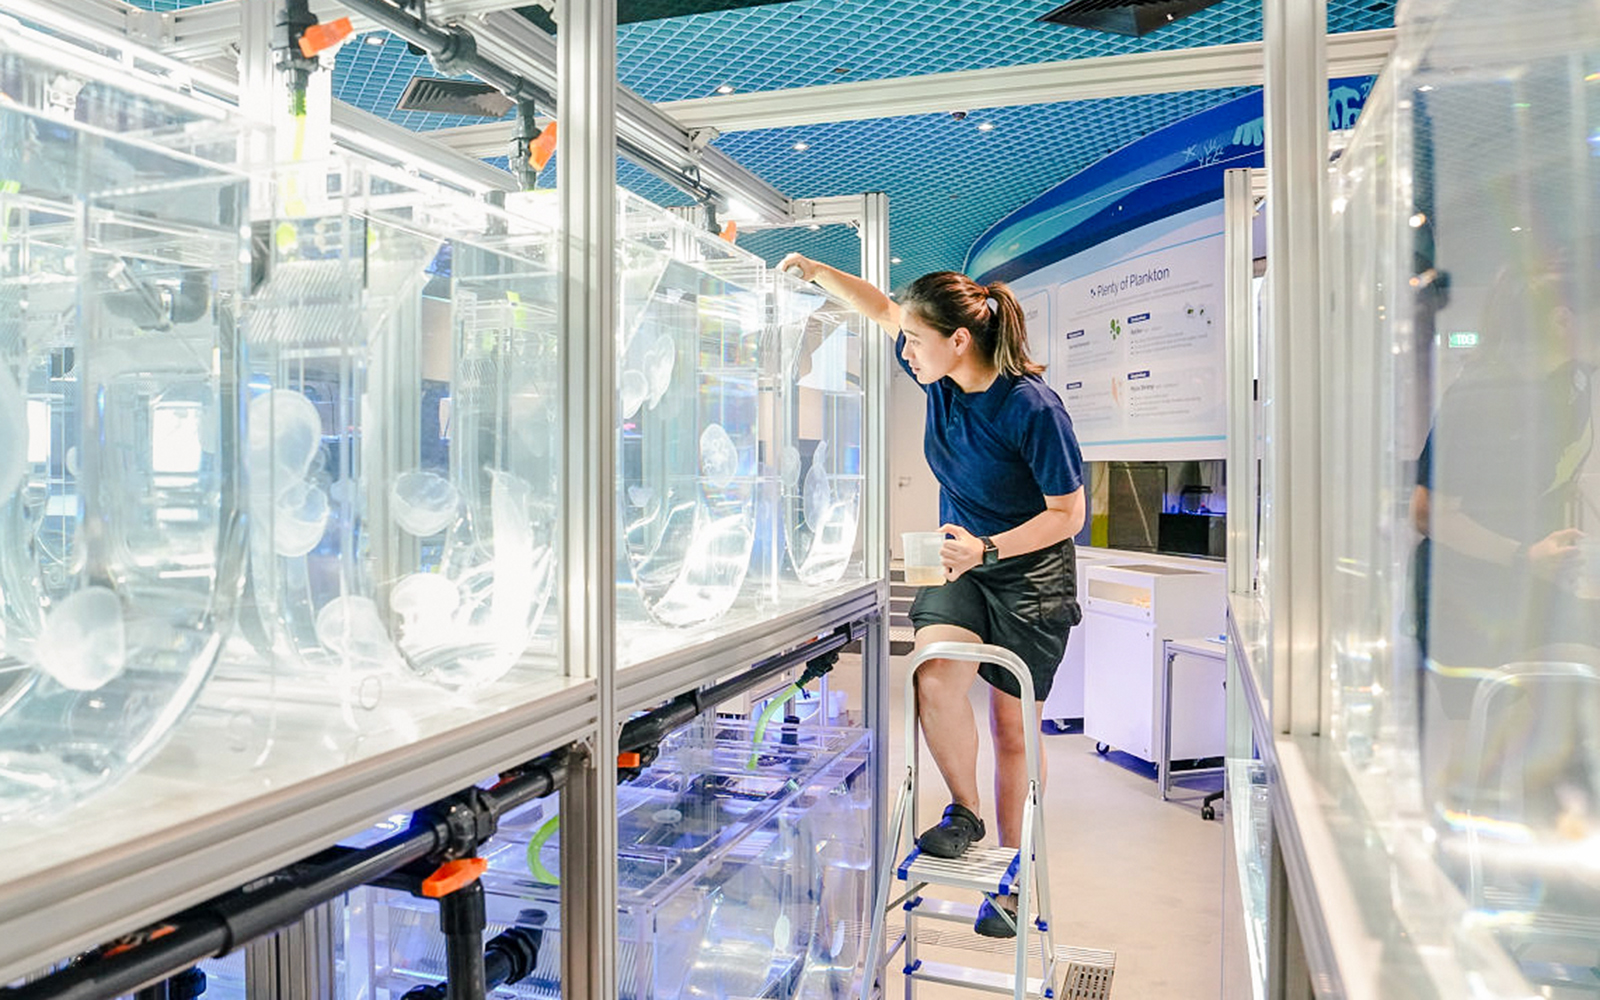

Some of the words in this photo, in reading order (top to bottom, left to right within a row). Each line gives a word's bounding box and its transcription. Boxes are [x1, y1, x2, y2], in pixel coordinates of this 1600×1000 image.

[1097, 281, 1118, 297] Plenty
[1120, 276, 1129, 290] of
[1130, 267, 1170, 286] Plankton
